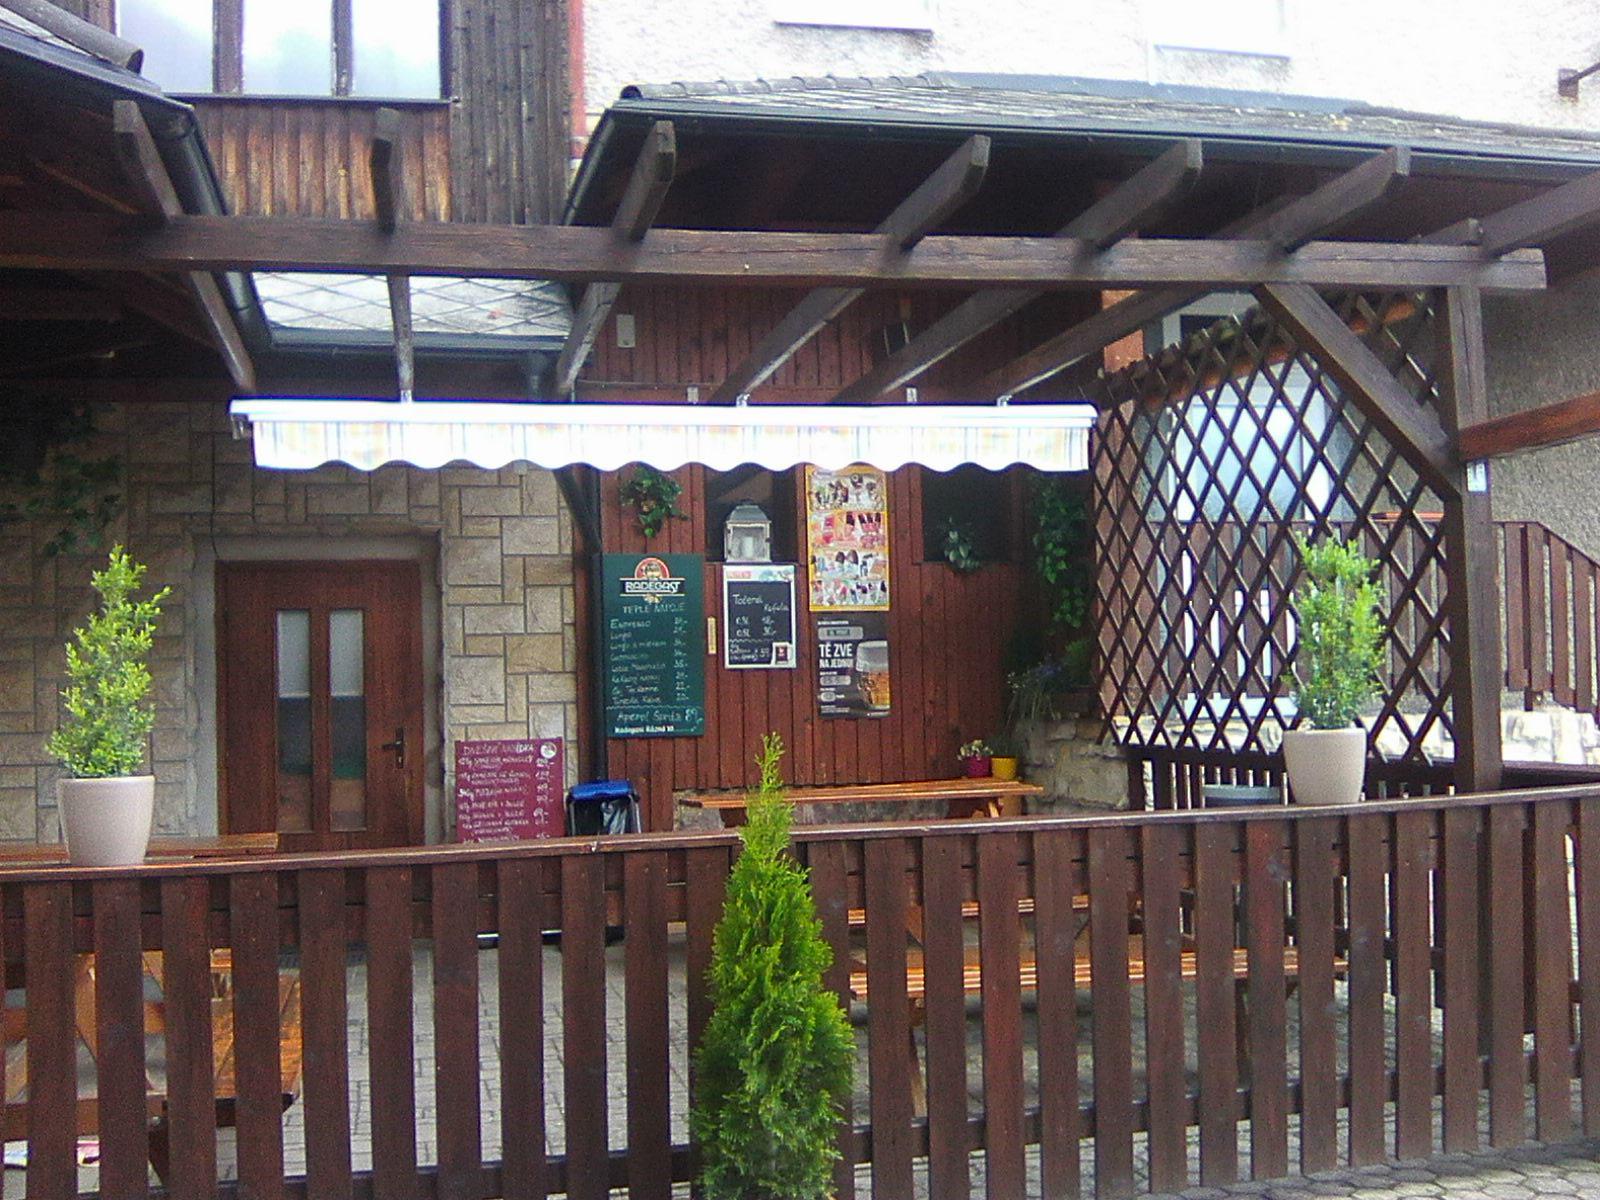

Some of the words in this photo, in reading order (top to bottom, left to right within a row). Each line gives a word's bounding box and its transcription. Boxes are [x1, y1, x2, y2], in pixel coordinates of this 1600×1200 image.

[625, 581, 681, 593] RADEGAST
[833, 643, 853, 658] ZVE
[819, 658, 831, 669] NA
